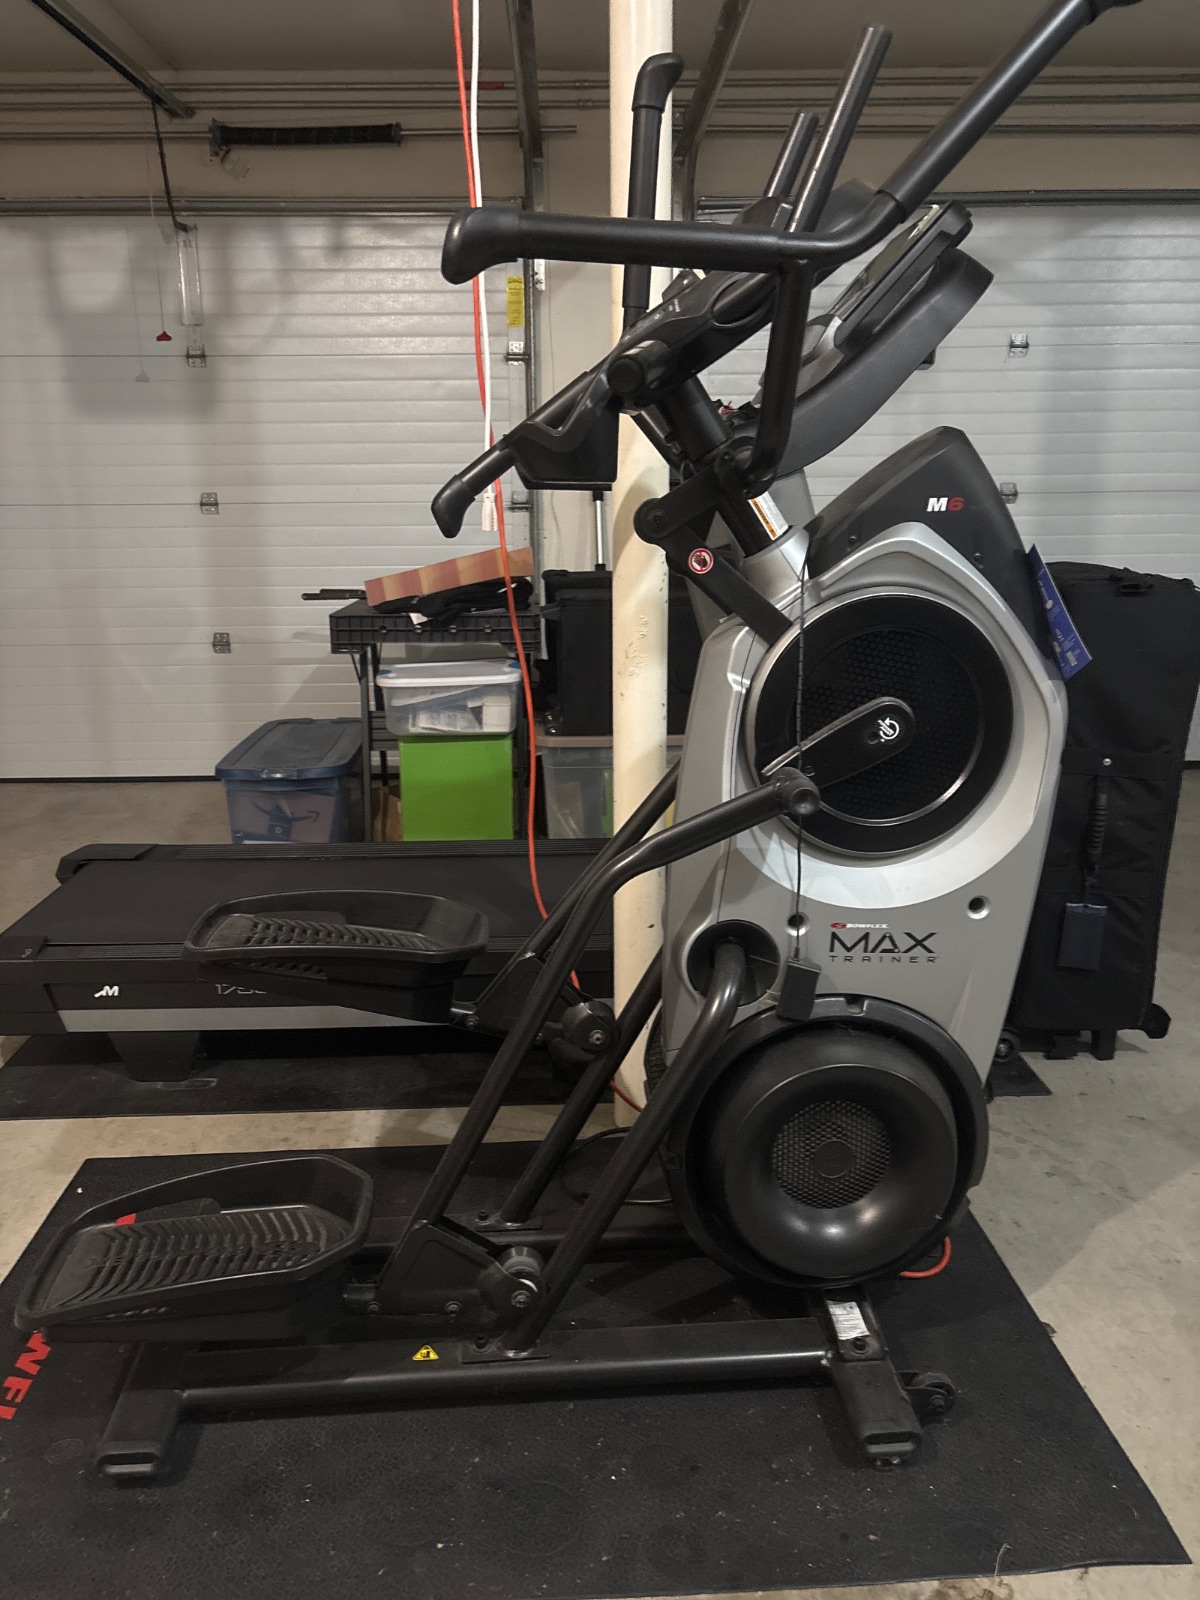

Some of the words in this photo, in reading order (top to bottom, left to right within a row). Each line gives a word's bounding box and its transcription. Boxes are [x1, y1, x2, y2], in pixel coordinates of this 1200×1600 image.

[926, 496, 966, 512] M6
[829, 931, 937, 954] MAX
[829, 955, 938, 964] TRAINER
